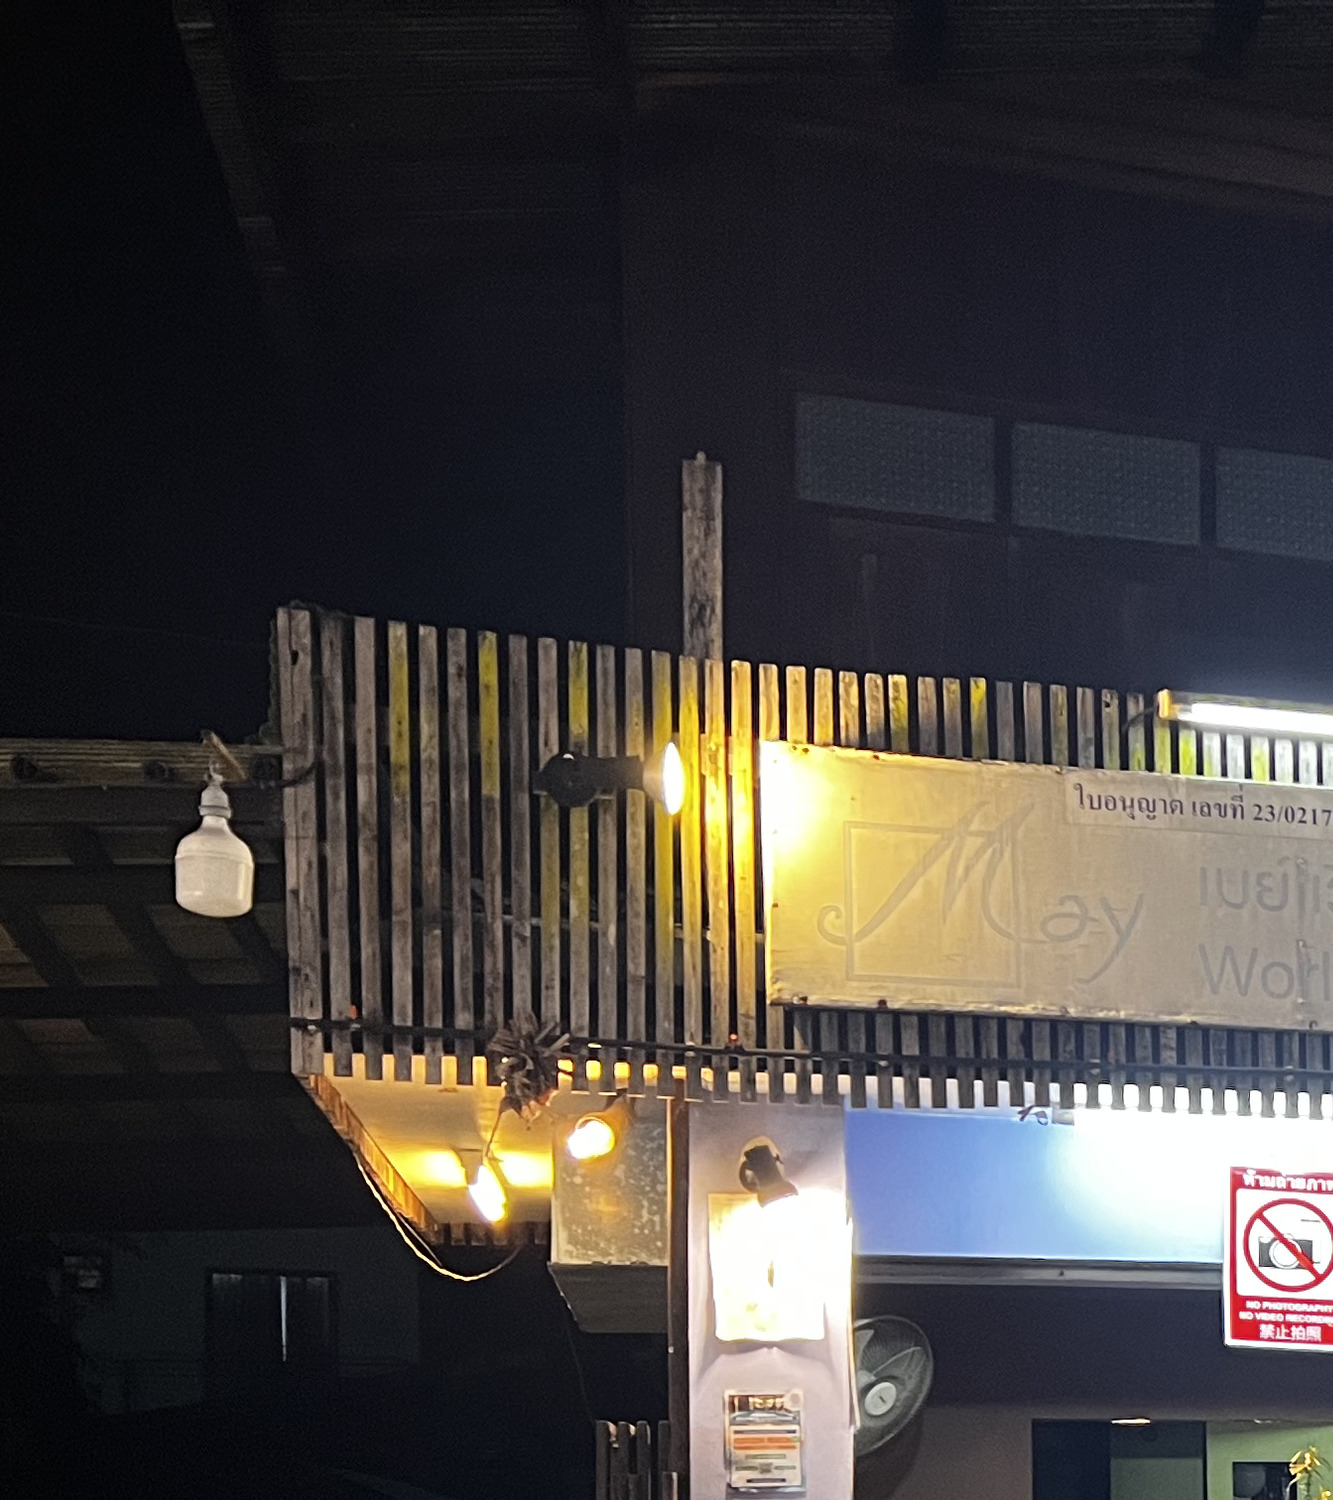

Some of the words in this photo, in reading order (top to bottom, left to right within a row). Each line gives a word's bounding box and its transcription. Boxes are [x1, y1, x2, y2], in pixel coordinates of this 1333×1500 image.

[1073, 783, 1184, 820] ใบอนุญาต
[1192, 785, 1245, 820] เลขที่
[1246, 1301, 1261, 1310] NO
[1262, 1301, 1333, 1313] PHOTOGRAPHY
[1239, 1312, 1253, 1320] NO
[1255, 1312, 1284, 1322] VIDEO
